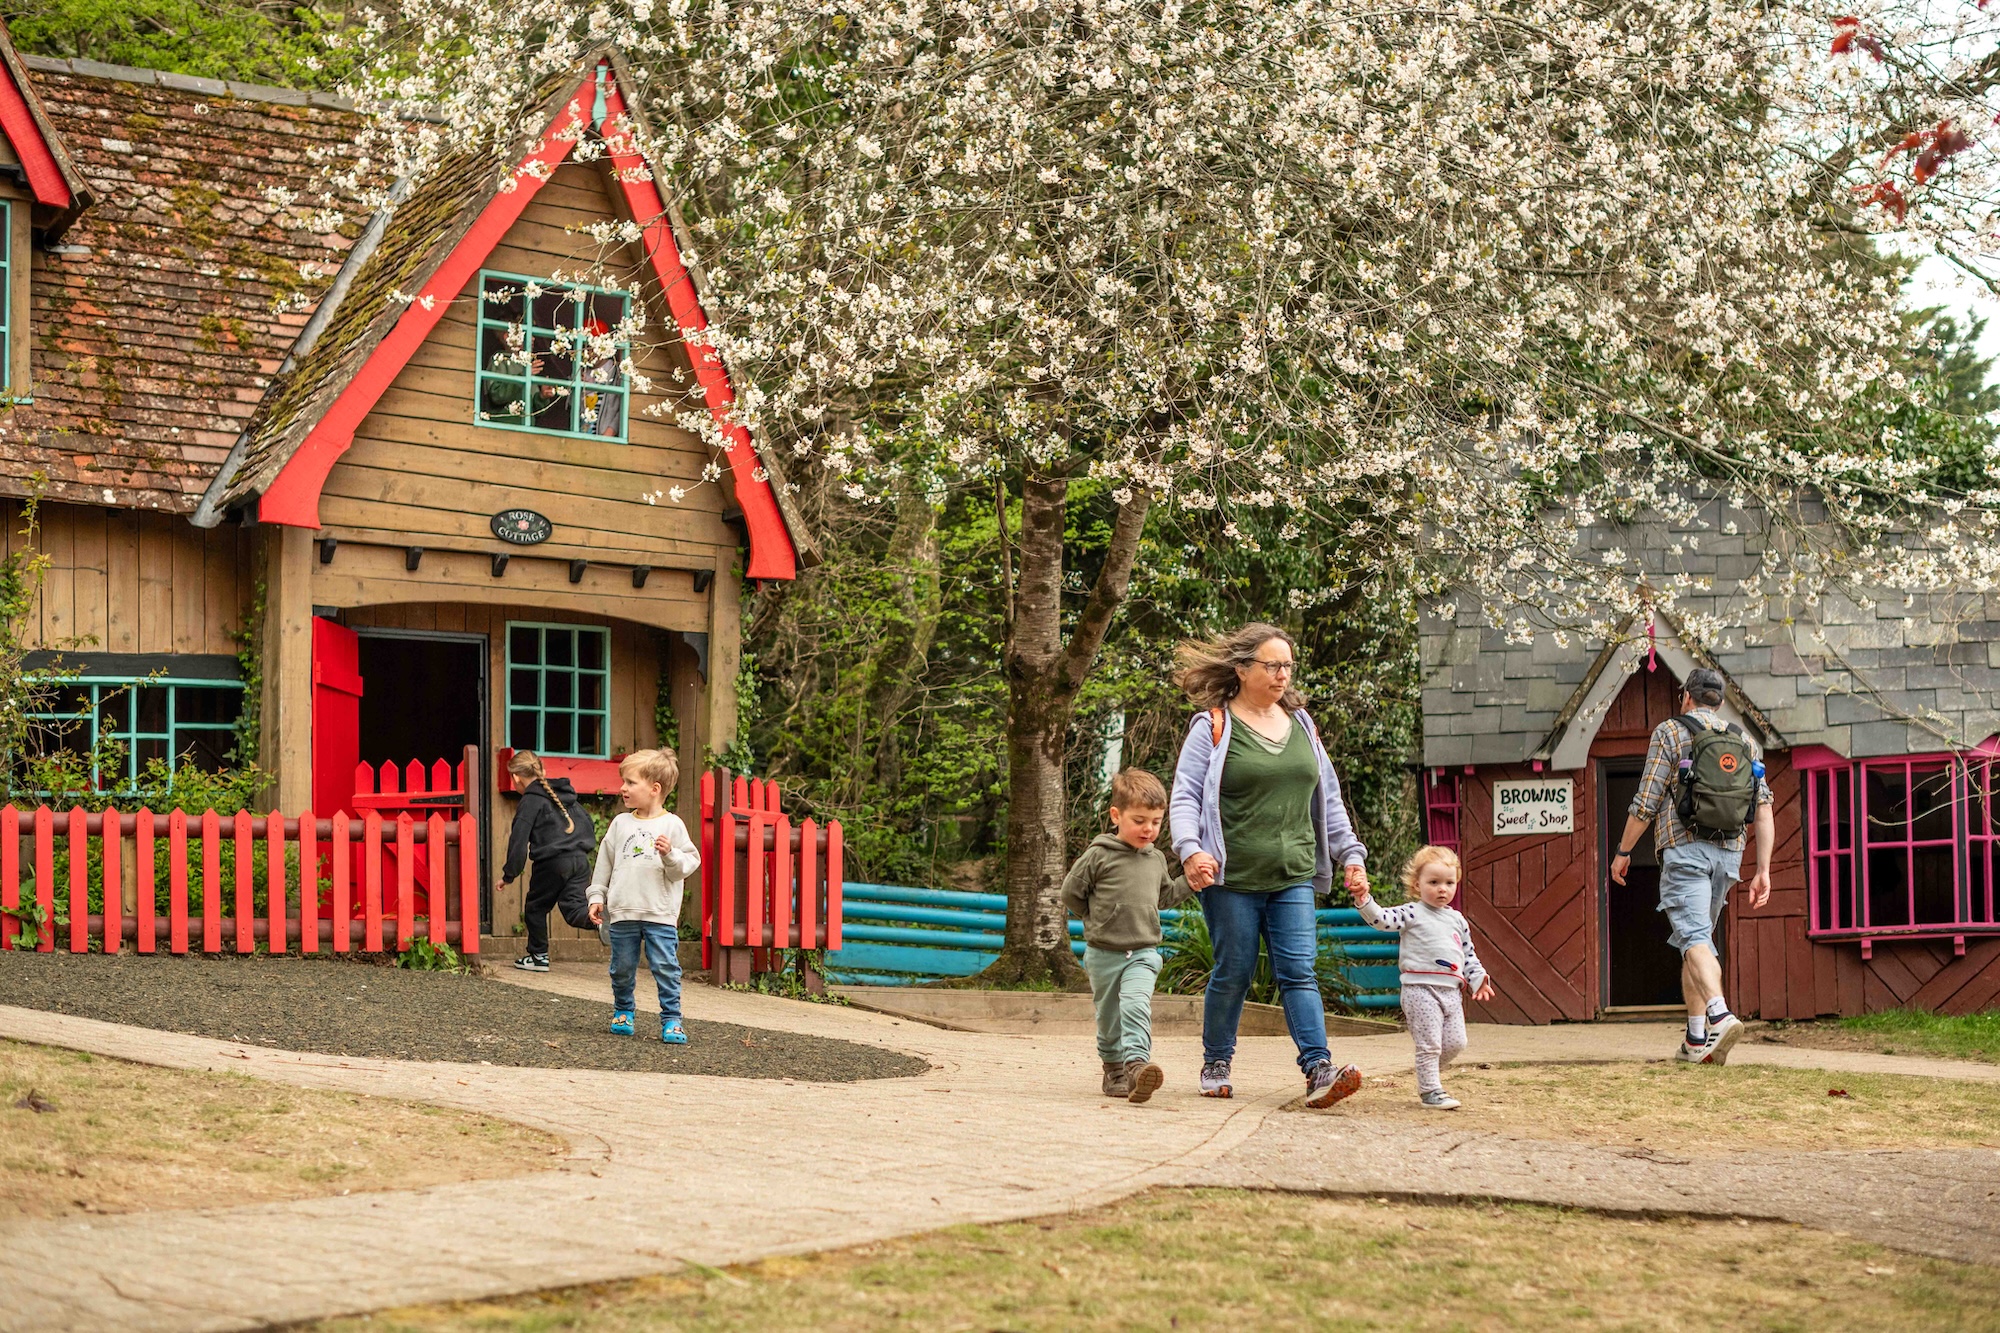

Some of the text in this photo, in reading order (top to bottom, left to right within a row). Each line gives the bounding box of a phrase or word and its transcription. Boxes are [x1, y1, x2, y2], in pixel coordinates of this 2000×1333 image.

[508, 511, 535, 521] ROSE
[498, 526, 545, 542] COTTAGE
[1501, 788, 1567, 805] BROWNS
[1497, 810, 1568, 829] Sweet Shop
